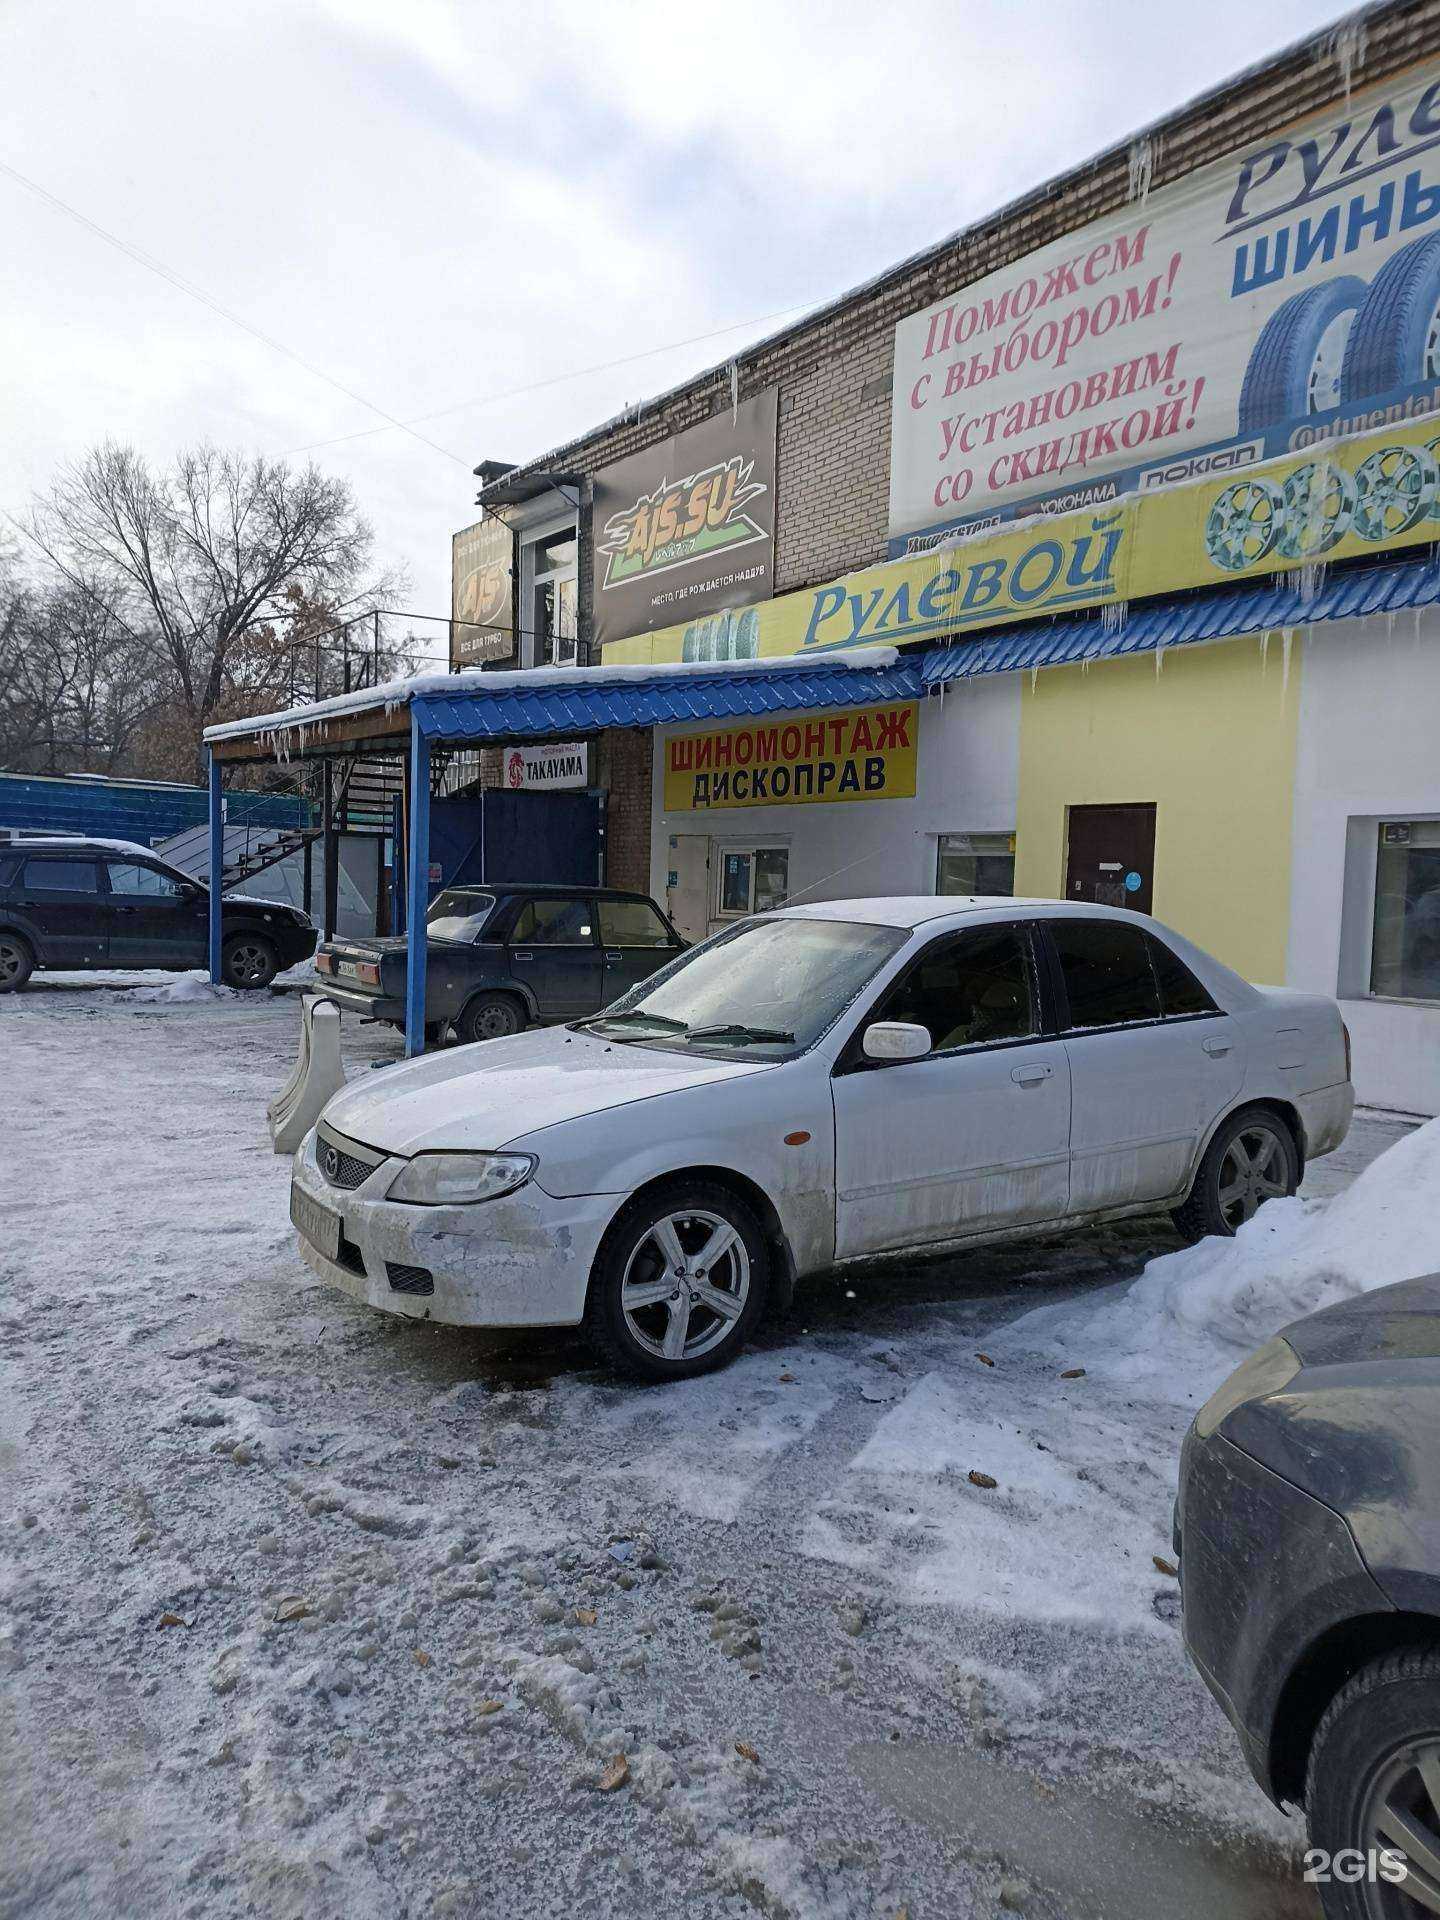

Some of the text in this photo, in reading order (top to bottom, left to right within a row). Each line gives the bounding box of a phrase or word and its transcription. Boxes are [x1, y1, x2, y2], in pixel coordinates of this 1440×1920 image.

[921, 223, 1152, 361] Поможем
[910, 251, 1183, 411] с выбором!
[933, 375, 1207, 508] со скидкой!
[1039, 481, 1117, 515] YOKOHAMA
[734, 564, 766, 582] НАДДУВ
[526, 755, 584, 781] TAKAYAMA
[670, 707, 913, 773] ШИНОМОНТАЖ
[691, 755, 887, 809] ДИСКОПРАВ
